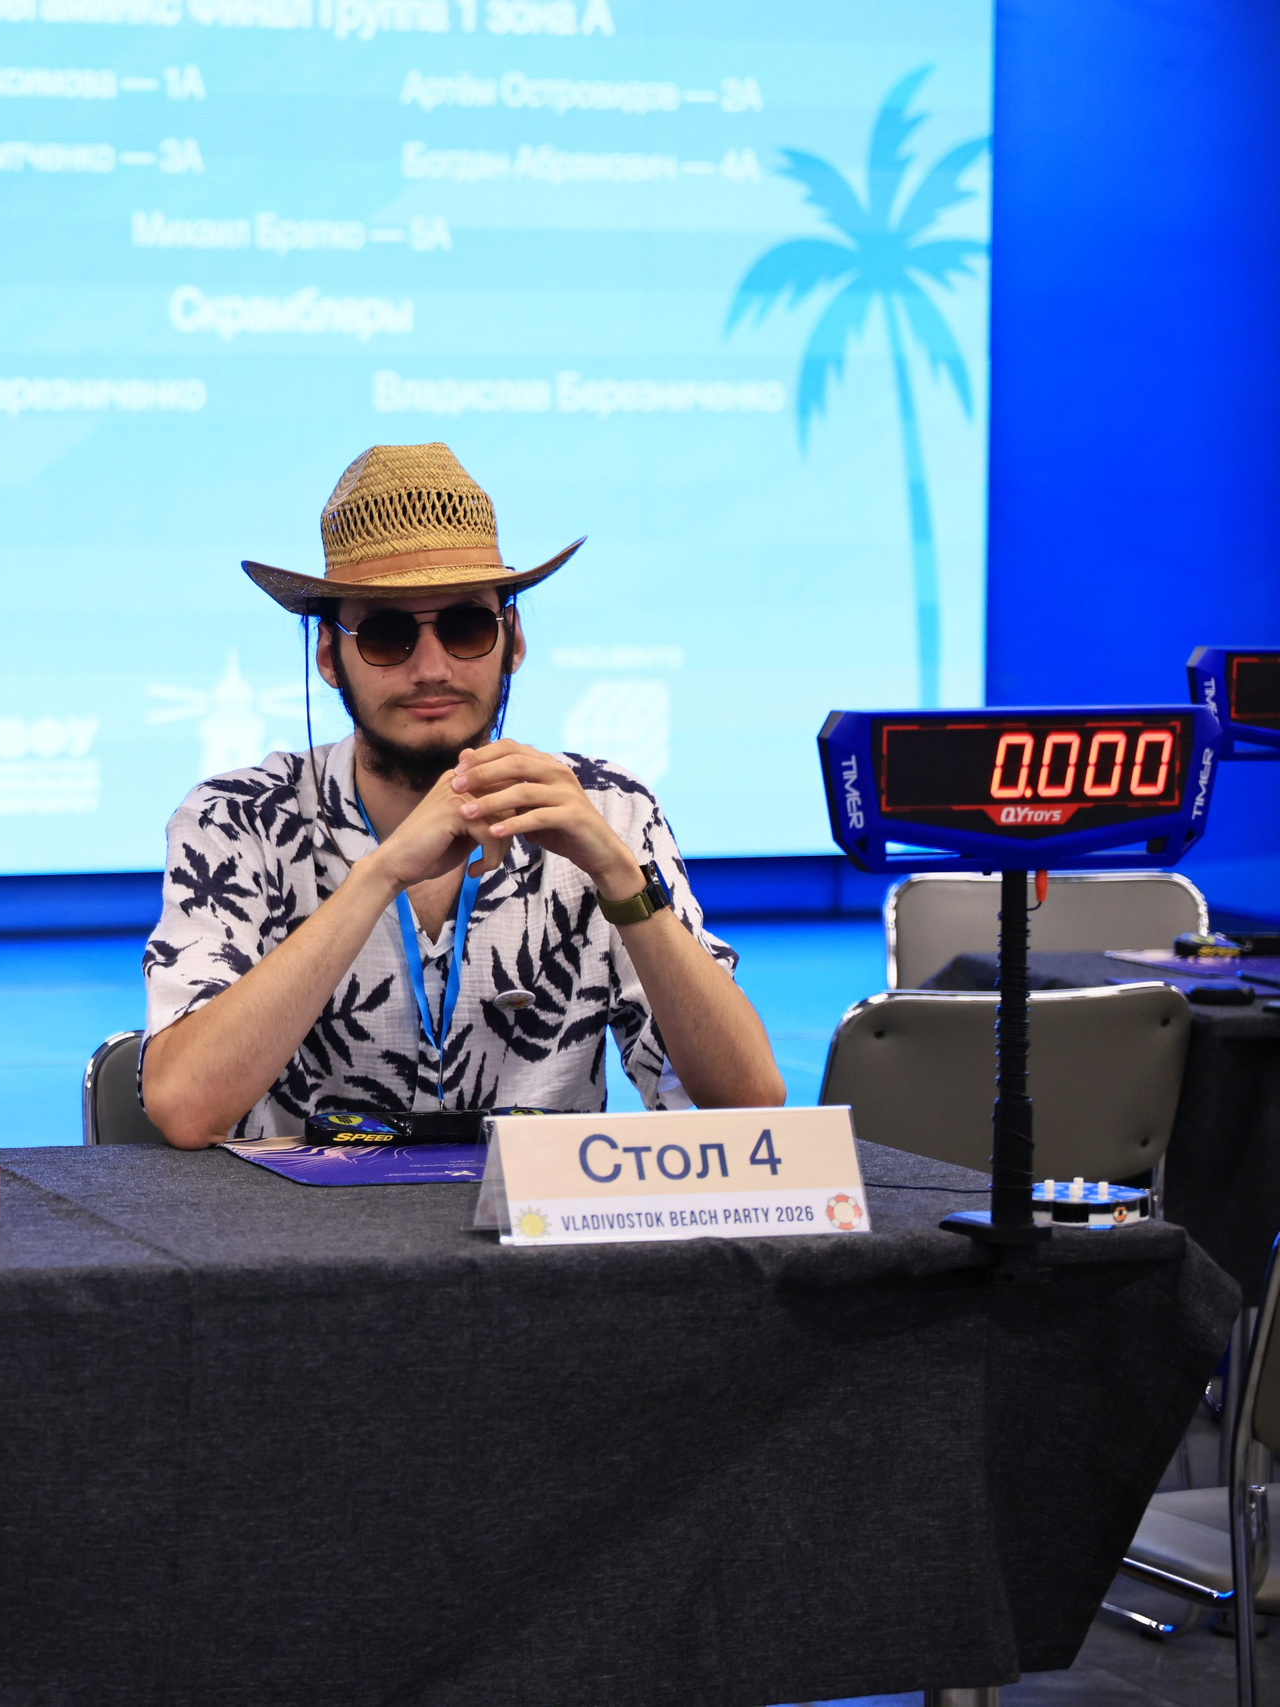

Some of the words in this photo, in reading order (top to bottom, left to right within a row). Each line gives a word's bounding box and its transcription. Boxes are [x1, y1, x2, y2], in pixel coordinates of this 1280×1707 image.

[402, 141, 512, 187] Богдан
[132, 211, 251, 249] Михаил
[168, 285, 414, 343] Скрамблеры
[373, 370, 552, 416] Владислав
[556, 370, 785, 418] Березниченко
[990, 730, 1174, 798] 0.000
[1191, 747, 1215, 820] TIMER
[841, 754, 865, 830] TIMER
[332, 1132, 394, 1142] SPEED
[578, 1133, 730, 1183] Стол
[749, 1128, 782, 1176] 4
[561, 1212, 665, 1231] VLADIVOSTOK
[670, 1209, 719, 1227] BEACH
[723, 1207, 771, 1225] PARTY
[775, 1205, 815, 1223] 2026
